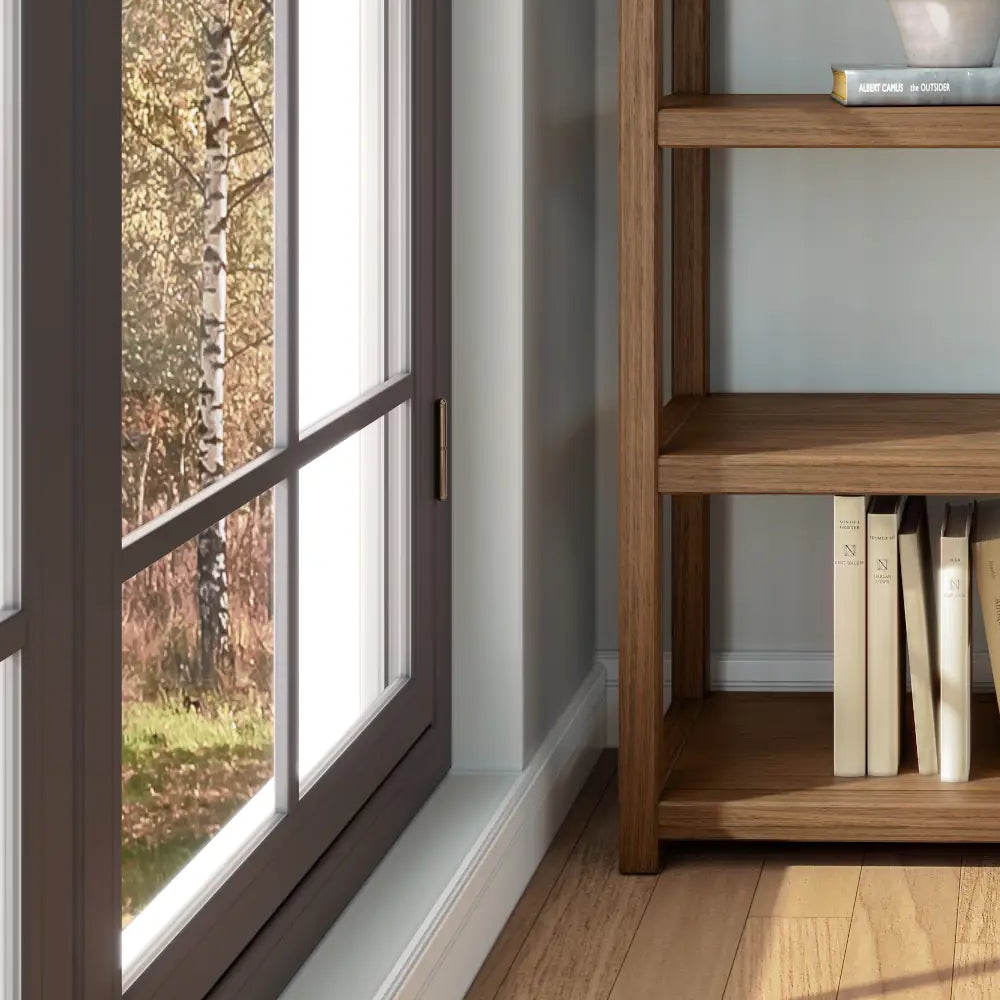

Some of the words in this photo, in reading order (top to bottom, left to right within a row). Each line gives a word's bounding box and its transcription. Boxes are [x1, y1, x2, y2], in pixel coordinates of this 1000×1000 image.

[858, 83, 880, 93] ALBERT
[881, 83, 904, 93] CAMUS
[910, 83, 920, 92] the
[920, 83, 951, 92] OUTSIDER
